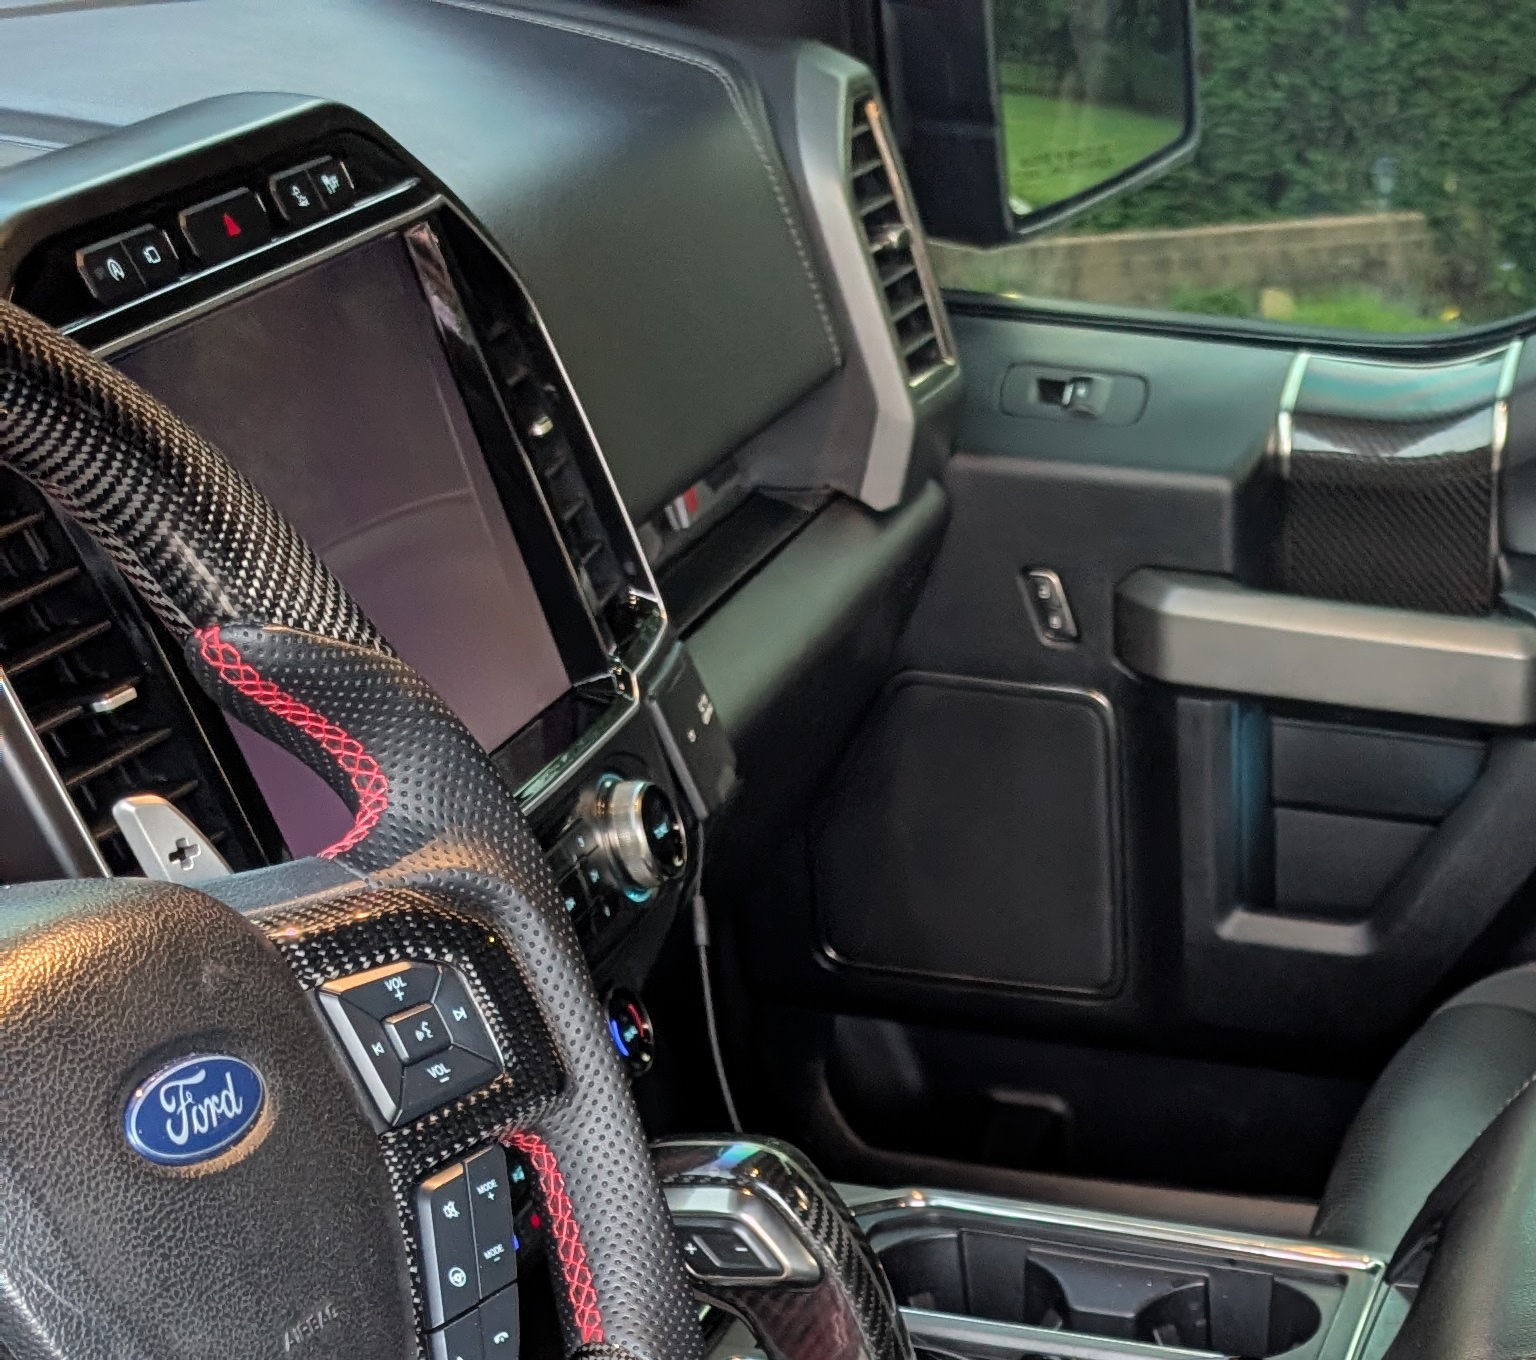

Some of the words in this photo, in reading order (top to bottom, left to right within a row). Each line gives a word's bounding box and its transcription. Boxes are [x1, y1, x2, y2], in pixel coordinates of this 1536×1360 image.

[384, 976, 408, 992] VOL
[426, 1062, 452, 1079] VOL
[159, 1068, 244, 1146] Ford
[476, 1178, 499, 1196] MODE
[483, 1243, 505, 1261] MODE
